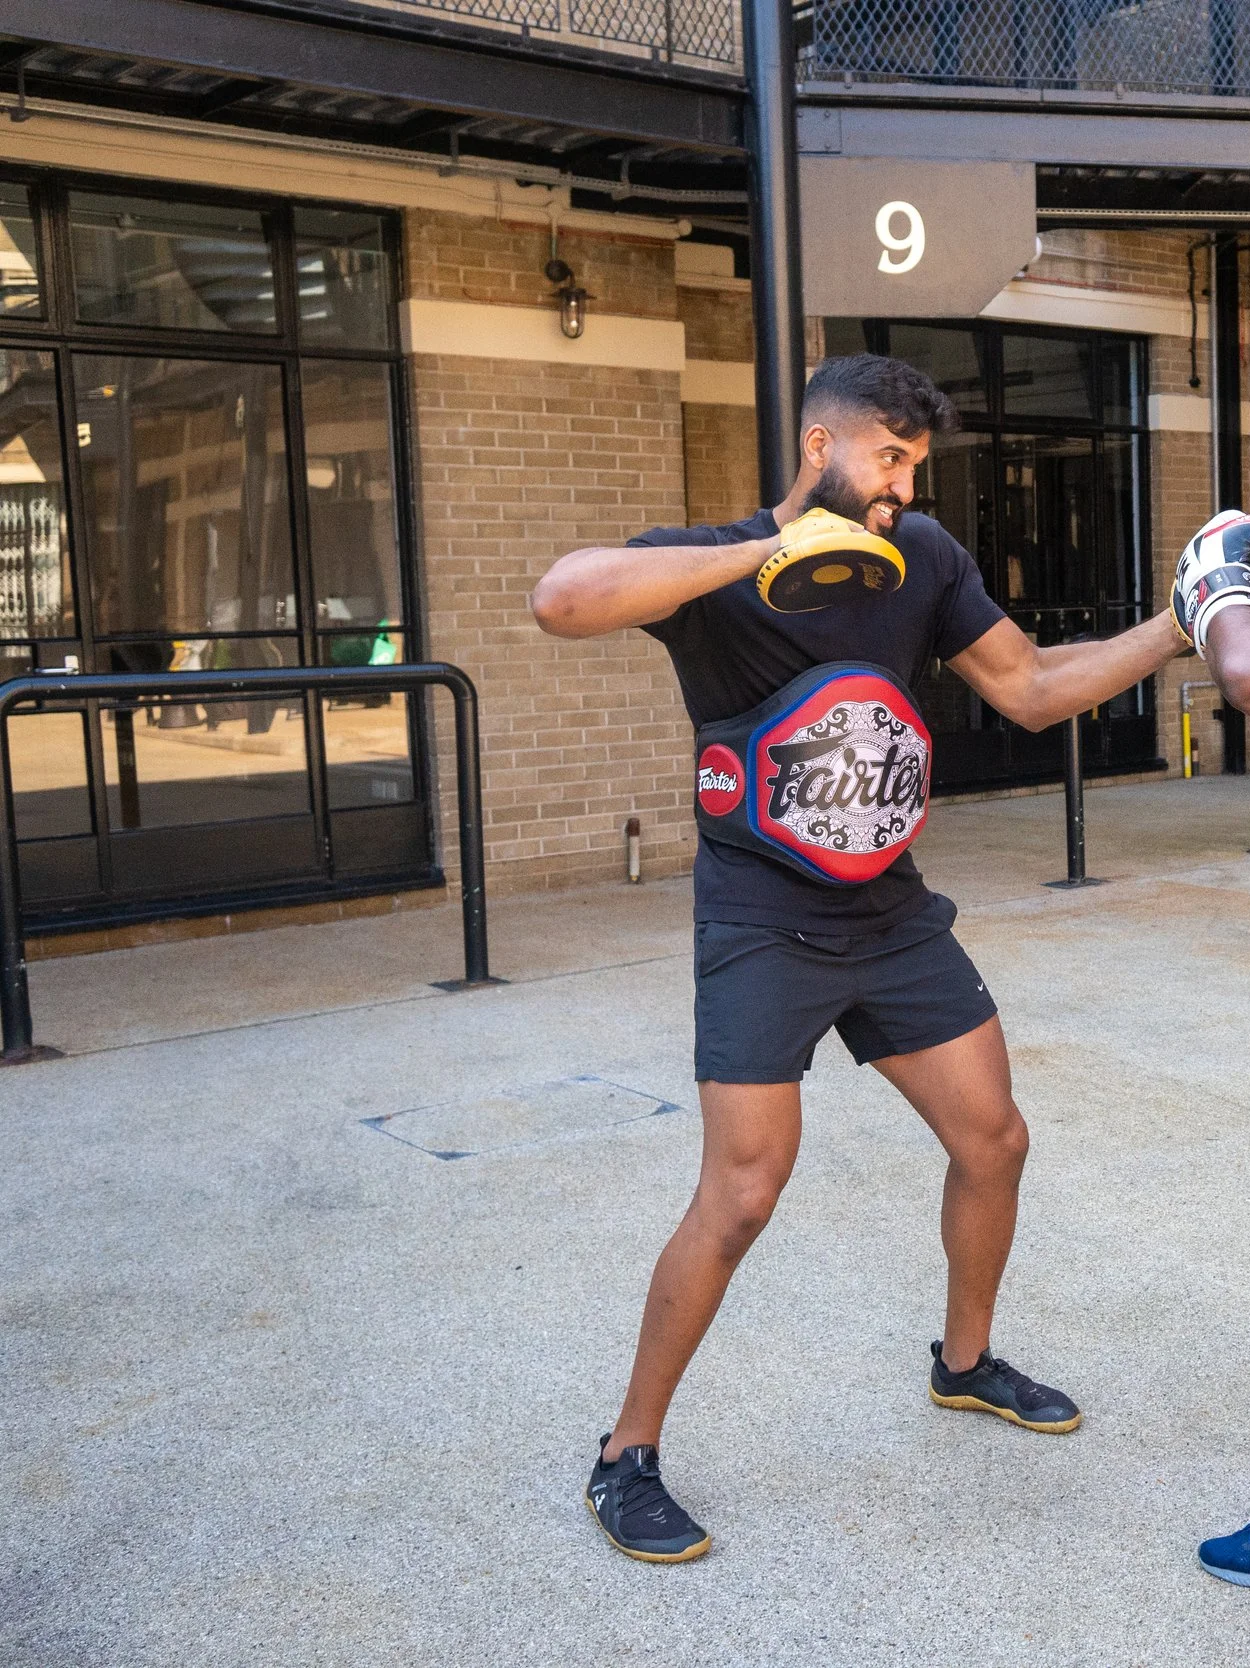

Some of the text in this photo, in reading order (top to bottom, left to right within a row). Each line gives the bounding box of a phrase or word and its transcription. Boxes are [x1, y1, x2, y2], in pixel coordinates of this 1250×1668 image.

[875, 201, 925, 274] 9
[698, 766, 738, 793] Fairtex
[766, 732, 929, 820] Fairtex
